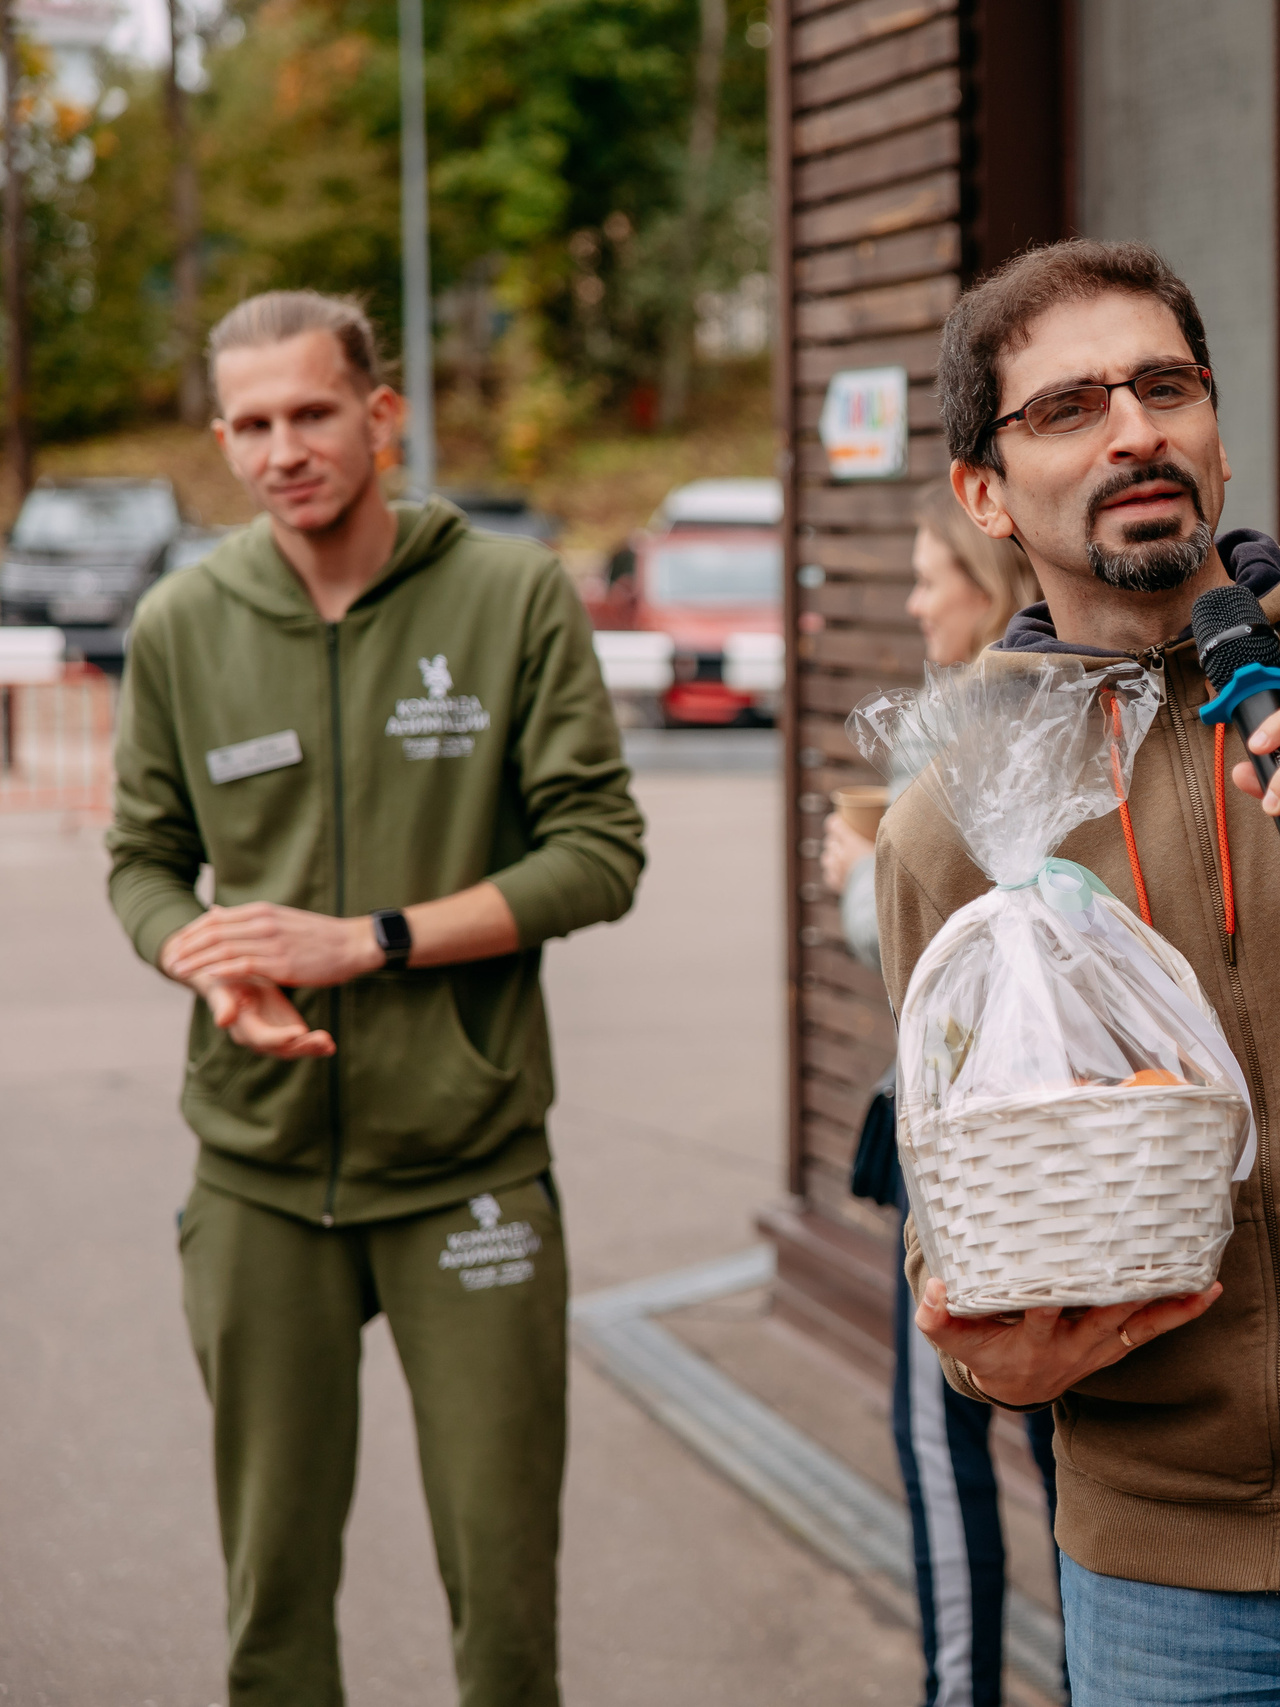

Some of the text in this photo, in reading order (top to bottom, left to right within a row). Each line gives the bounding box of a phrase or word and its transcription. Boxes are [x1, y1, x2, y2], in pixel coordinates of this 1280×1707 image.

[395, 696, 483, 717] КОМАНДА
[385, 713, 490, 737] АНИМАЦИИ
[447, 1222, 534, 1252] КОМАНДА
[438, 1235, 542, 1270] АНИМАЦИИ
